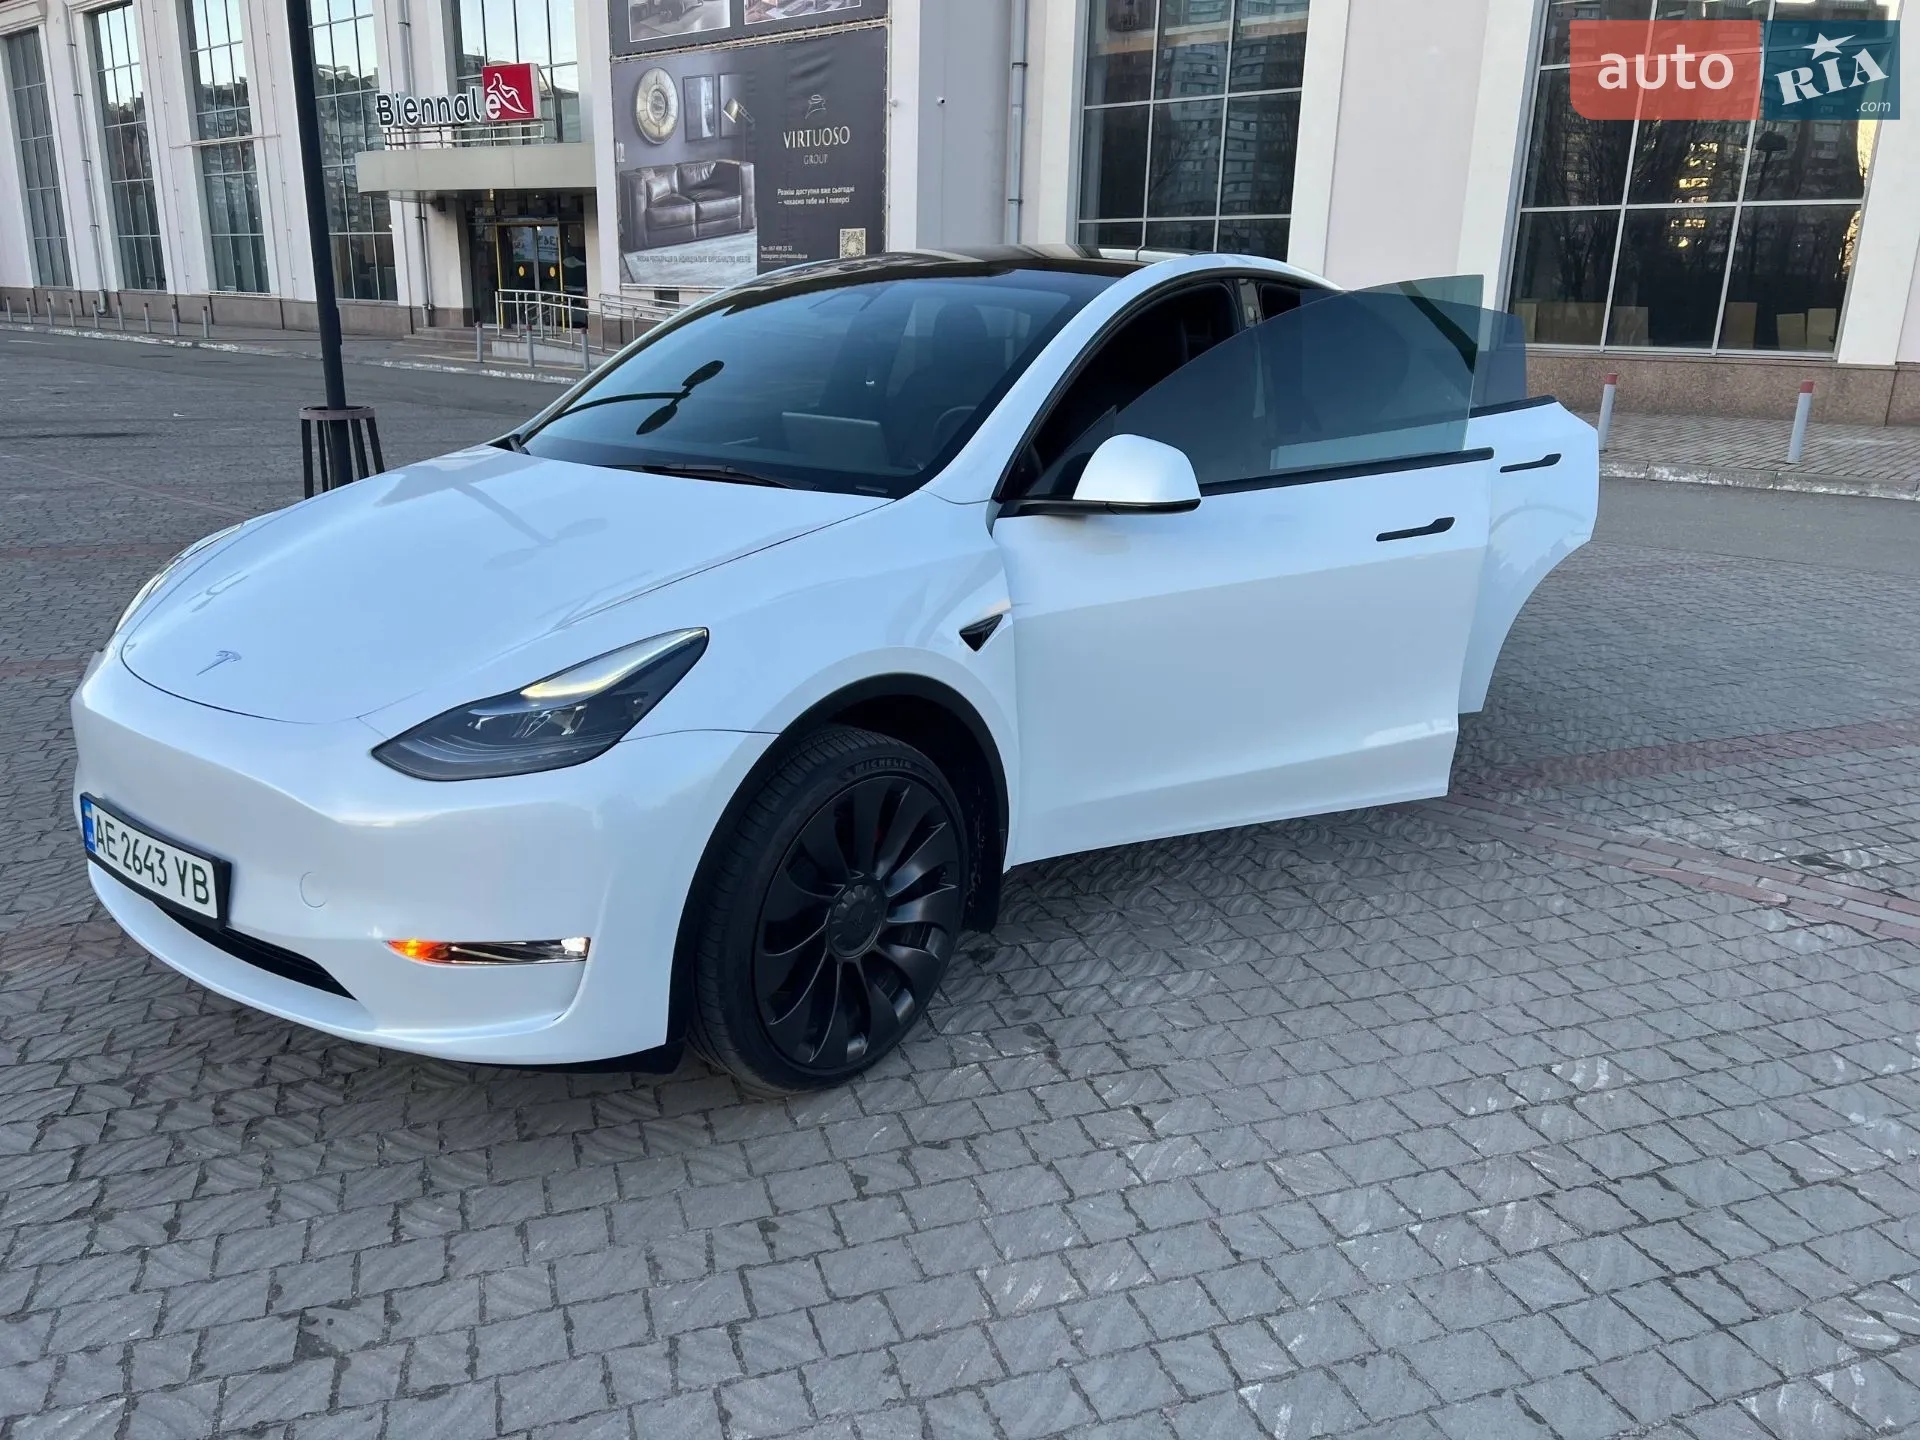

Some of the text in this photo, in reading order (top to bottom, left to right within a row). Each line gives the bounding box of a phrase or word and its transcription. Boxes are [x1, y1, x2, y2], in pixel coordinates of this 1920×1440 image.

[376, 85, 501, 127] Biennale
[783, 126, 850, 149] VIRTUOSO
[96, 814, 210, 905] AE 2643 YB
